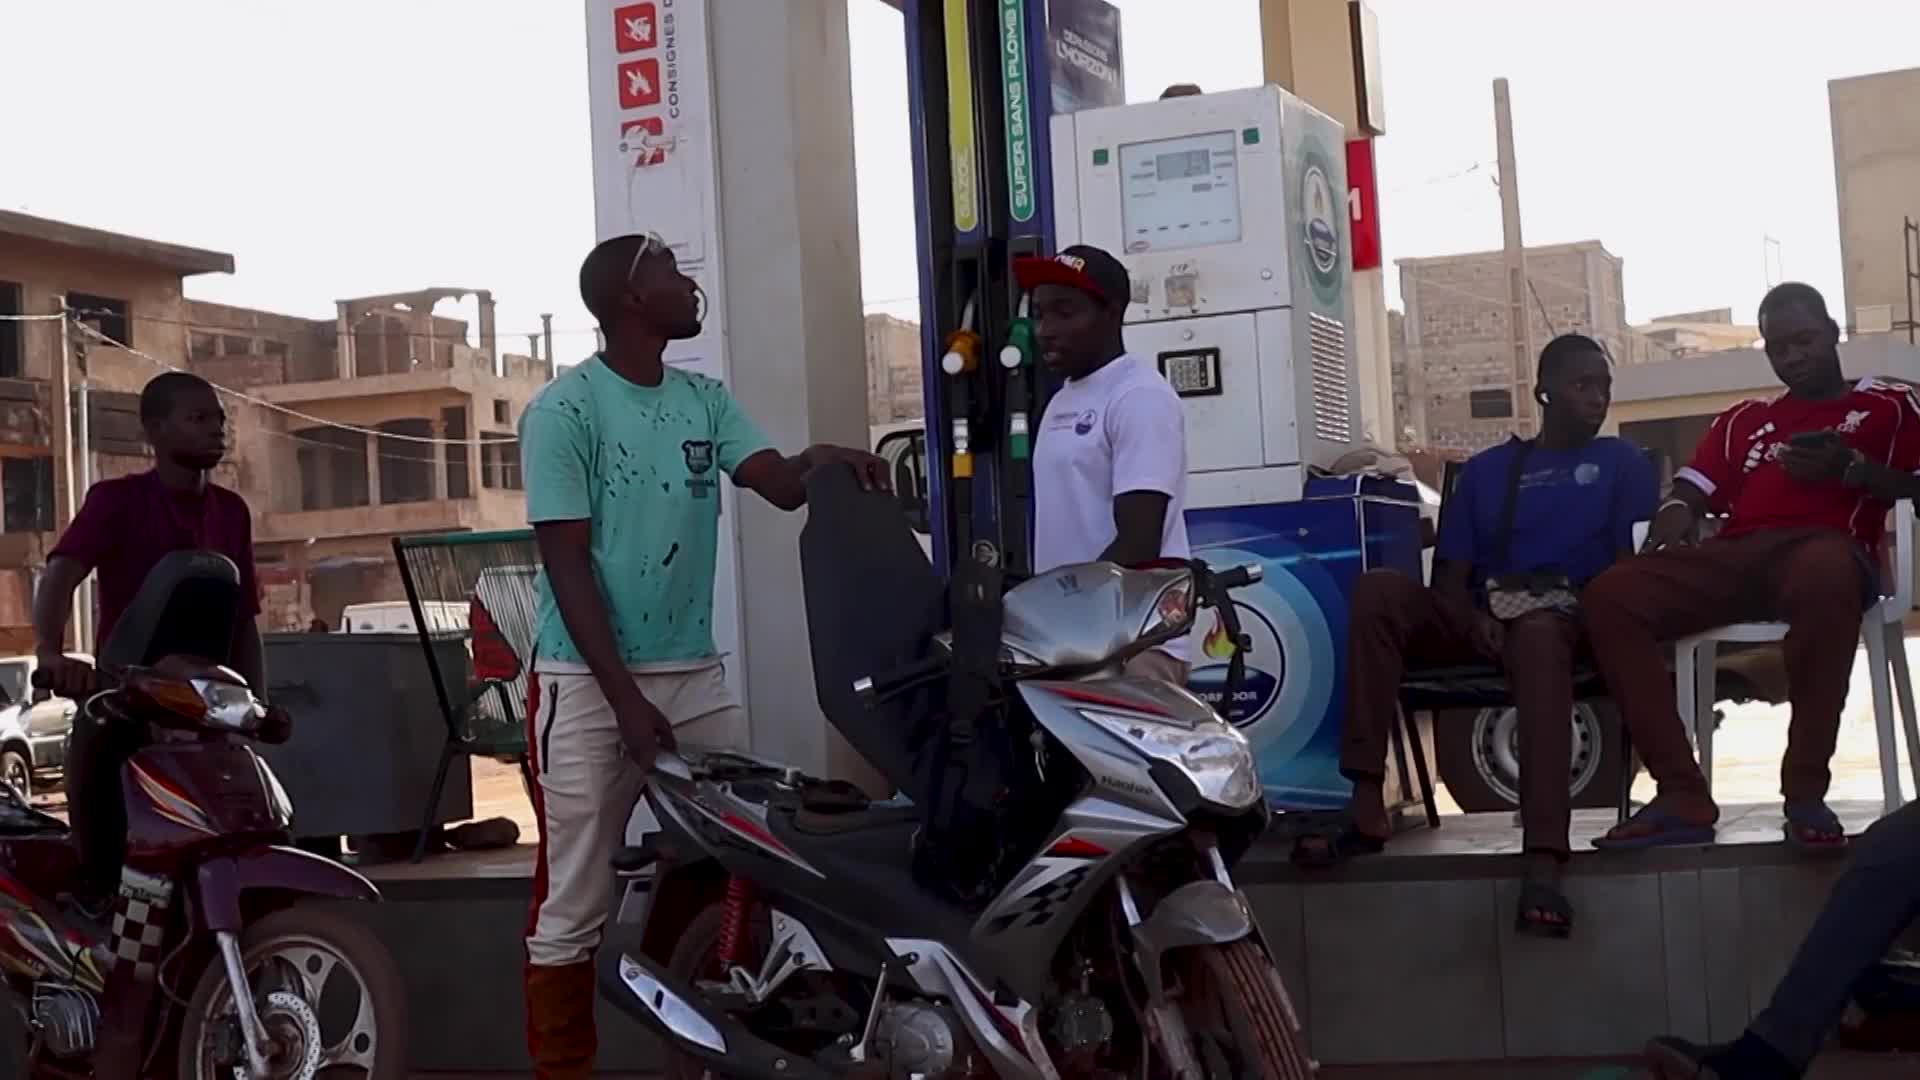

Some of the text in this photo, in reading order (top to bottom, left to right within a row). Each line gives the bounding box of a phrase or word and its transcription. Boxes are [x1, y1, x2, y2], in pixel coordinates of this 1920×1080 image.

[663, 13, 680, 119] CONSIGNES
[1005, 8, 1020, 79] PLOMB
[1008, 81, 1024, 137] SANS
[1012, 140, 1028, 208] SUPER
